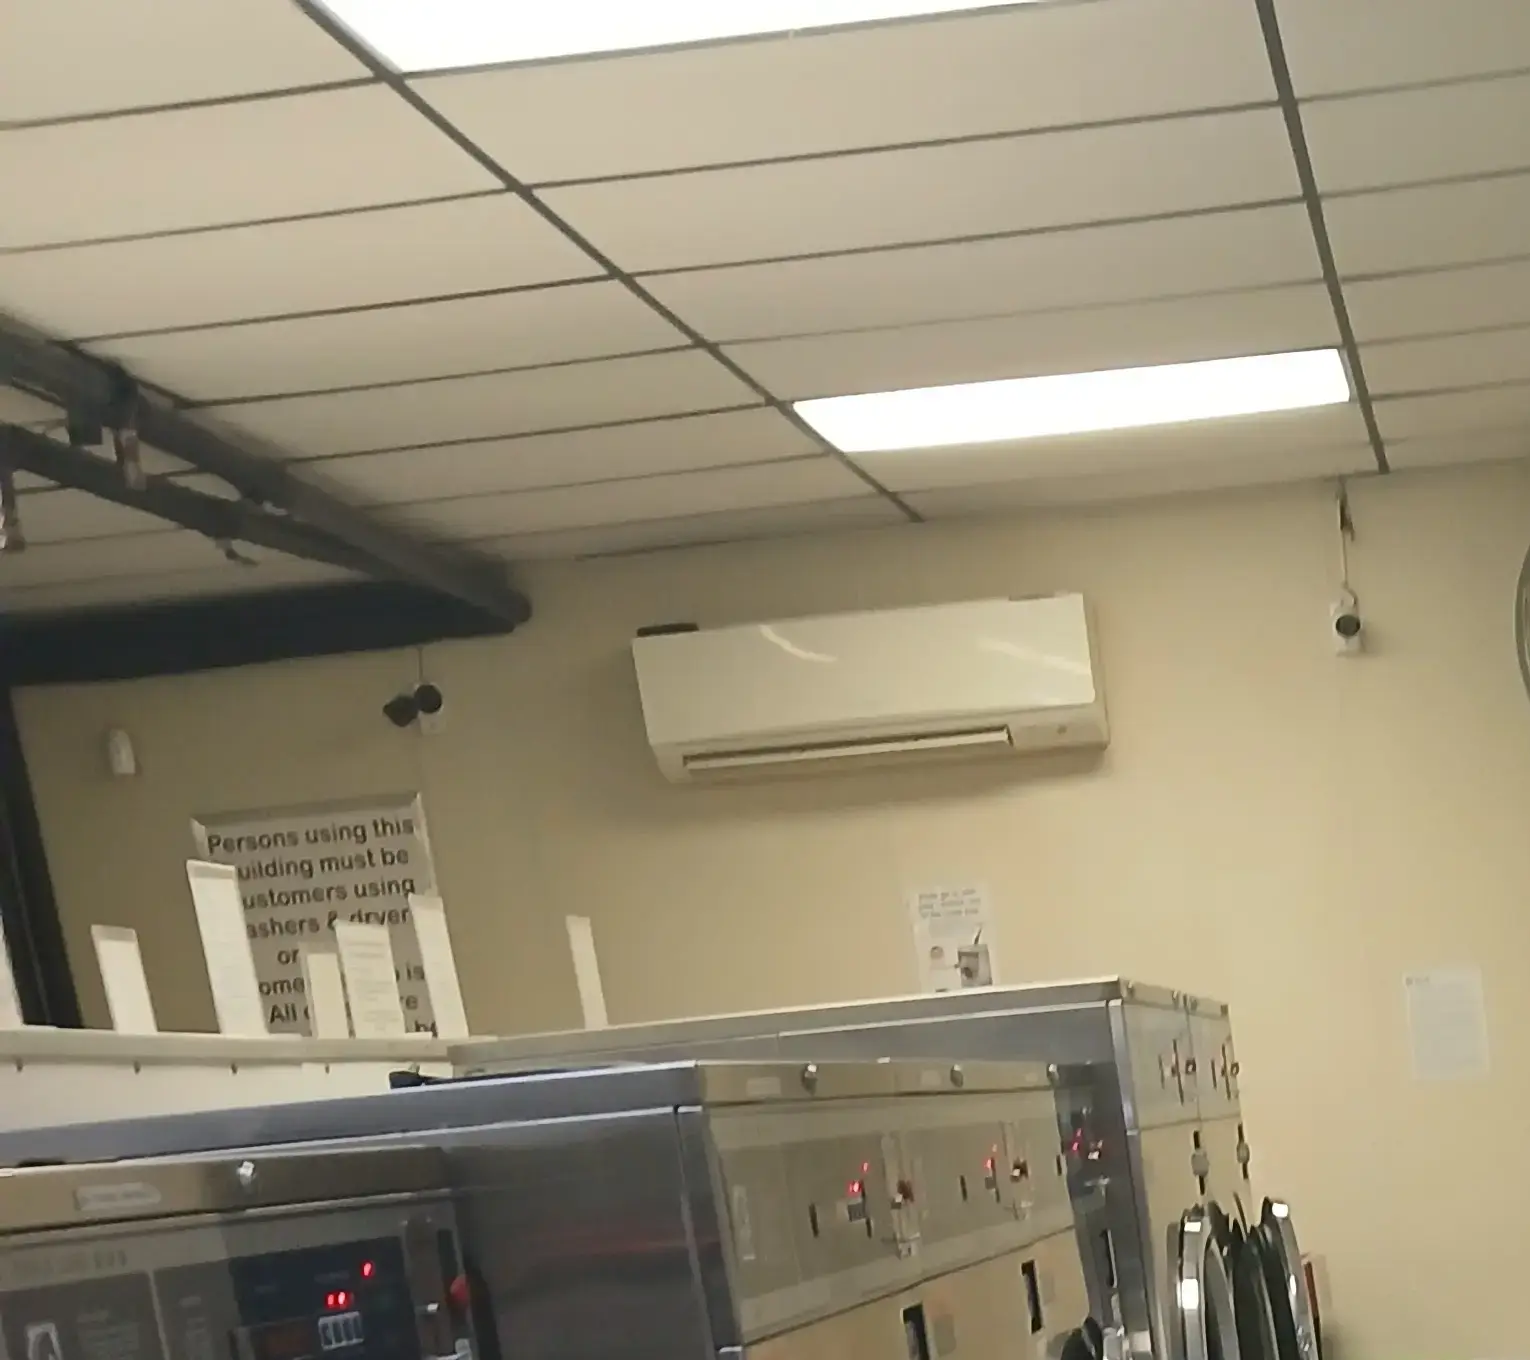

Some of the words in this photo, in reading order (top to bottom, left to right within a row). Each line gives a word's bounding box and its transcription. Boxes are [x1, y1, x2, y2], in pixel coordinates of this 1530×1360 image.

[207, 830, 299, 854] Persons
[304, 822, 367, 844] using
[372, 816, 414, 838] this
[237, 856, 314, 879] uilding
[319, 848, 376, 873] must
[380, 847, 409, 867] be
[242, 882, 347, 910] ustomers
[354, 876, 416, 896] using
[246, 916, 320, 939] ashers
[269, 1003, 298, 1024] All
